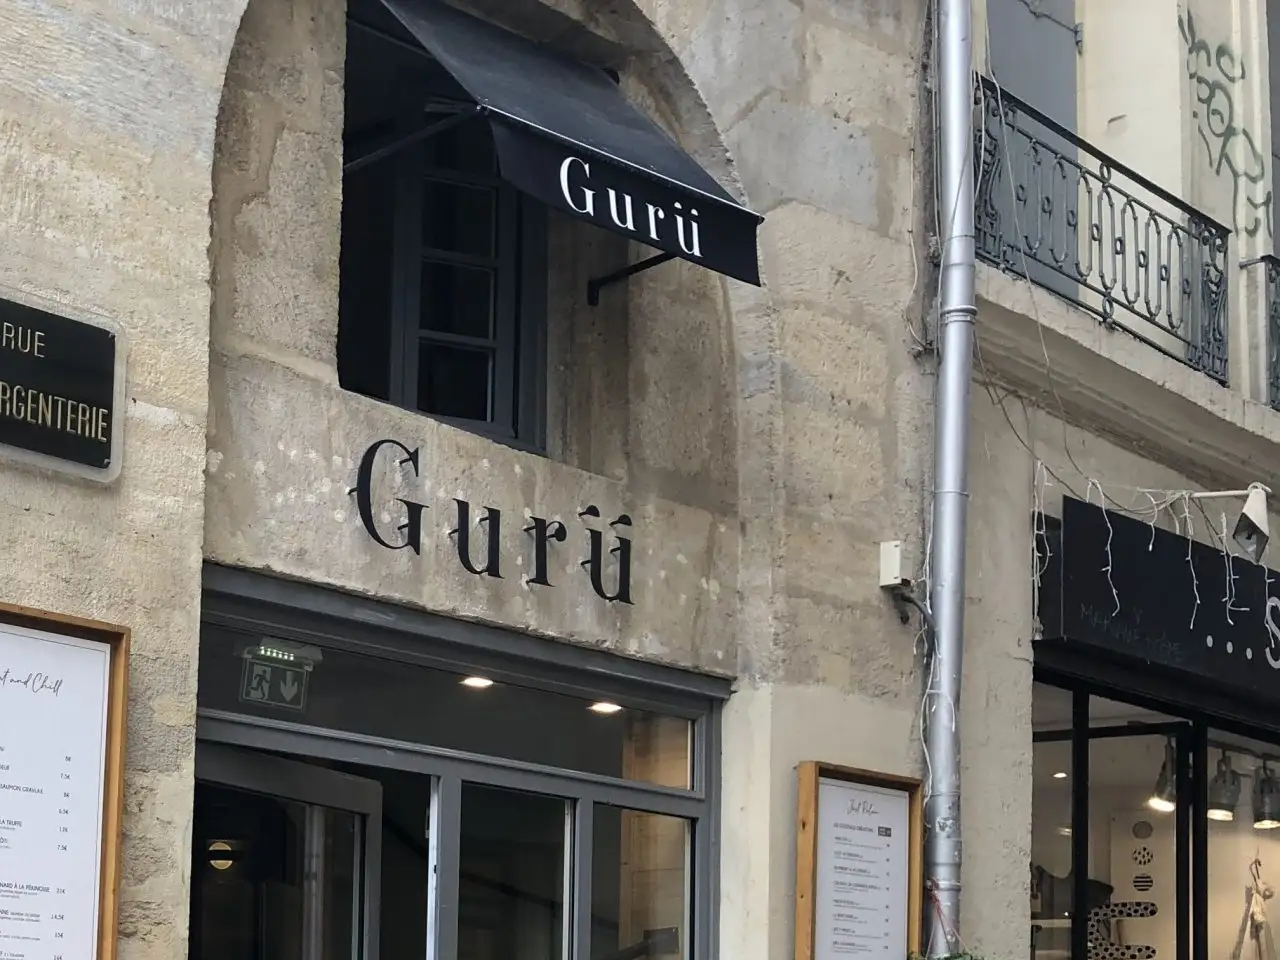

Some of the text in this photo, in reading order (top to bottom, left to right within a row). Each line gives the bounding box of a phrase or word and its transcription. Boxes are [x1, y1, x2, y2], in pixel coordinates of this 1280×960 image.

[559, 156, 703, 257] Gurü
[2, 322, 45, 358] RUE
[356, 439, 634, 605] Gurü
[10, 673, 32, 688] and
[32, 672, 63, 697] Chill
